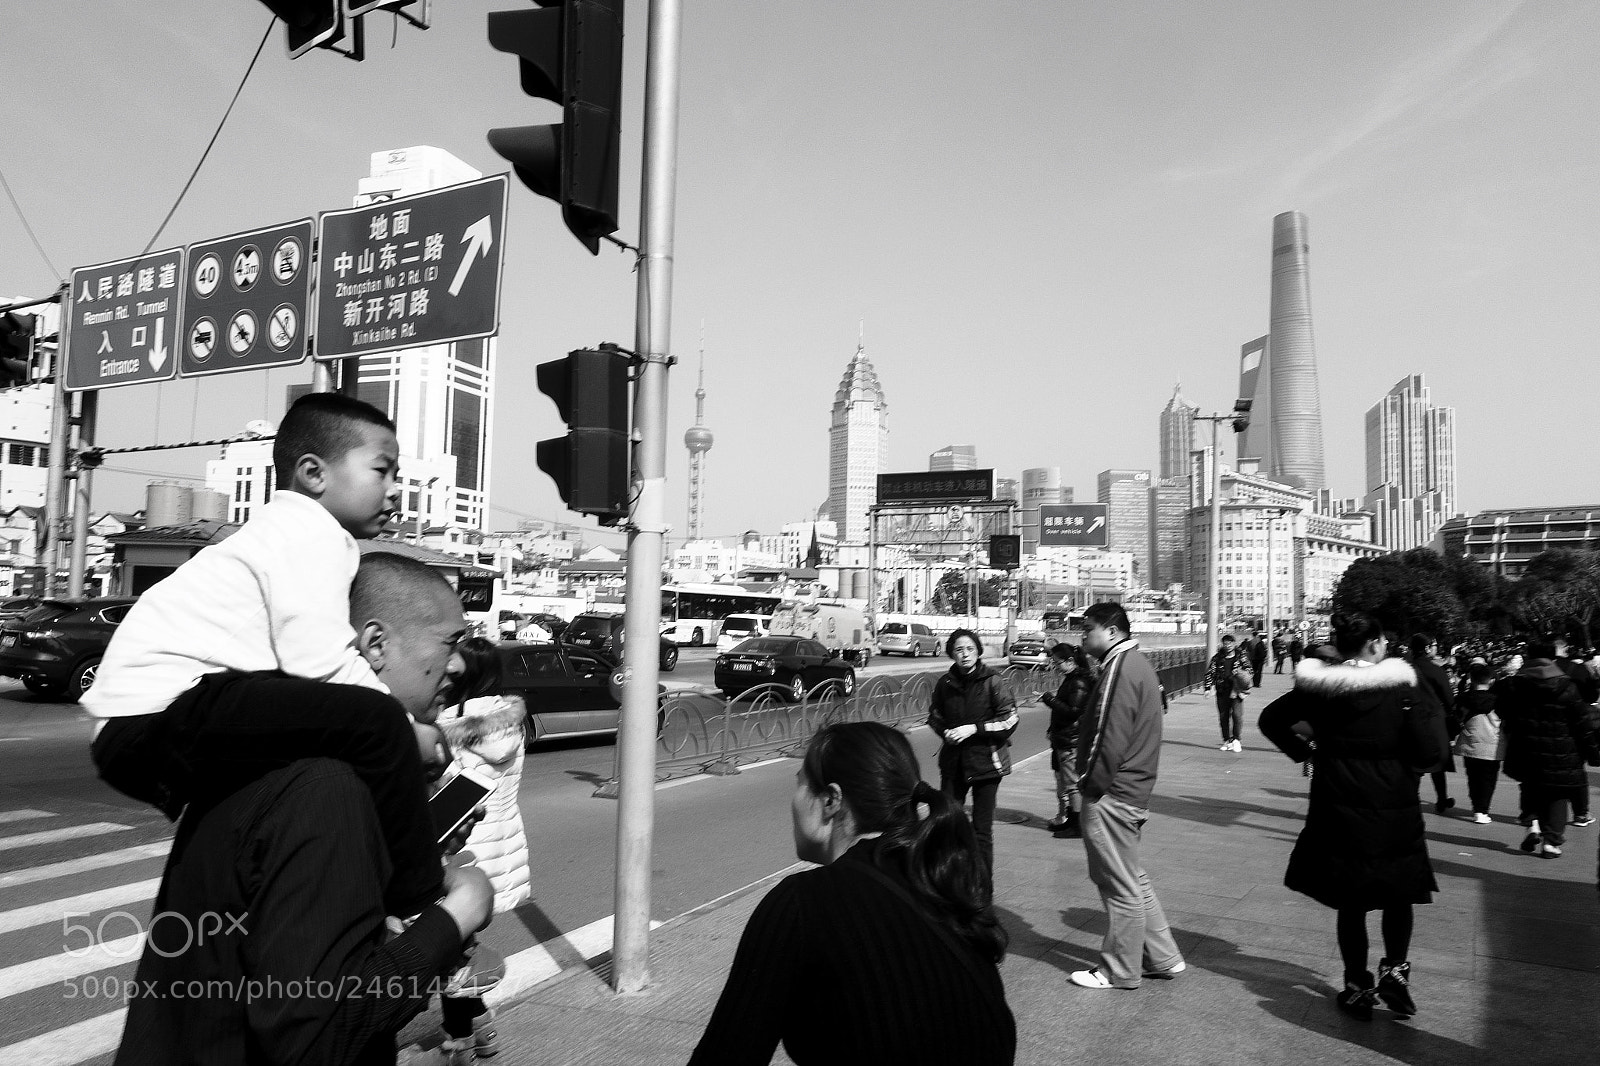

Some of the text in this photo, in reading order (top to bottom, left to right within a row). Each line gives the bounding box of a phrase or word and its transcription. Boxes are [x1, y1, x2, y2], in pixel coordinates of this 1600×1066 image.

[369, 208, 412, 241] 地面
[333, 232, 445, 279] 中山东二路
[76, 262, 177, 305] 人民路隧道
[198, 266, 216, 284] 40
[335, 278, 382, 299] Zhongshan
[398, 271, 406, 288] 2
[423, 265, 440, 282] (E)
[82, 308, 114, 326] Renmin
[136, 297, 169, 317] Tunnel
[342, 287, 430, 328] 新开河路
[96, 325, 148, 355] 入口
[352, 321, 417, 346] Xinkaihe Rd.
[99, 358, 140, 378] Entrance
